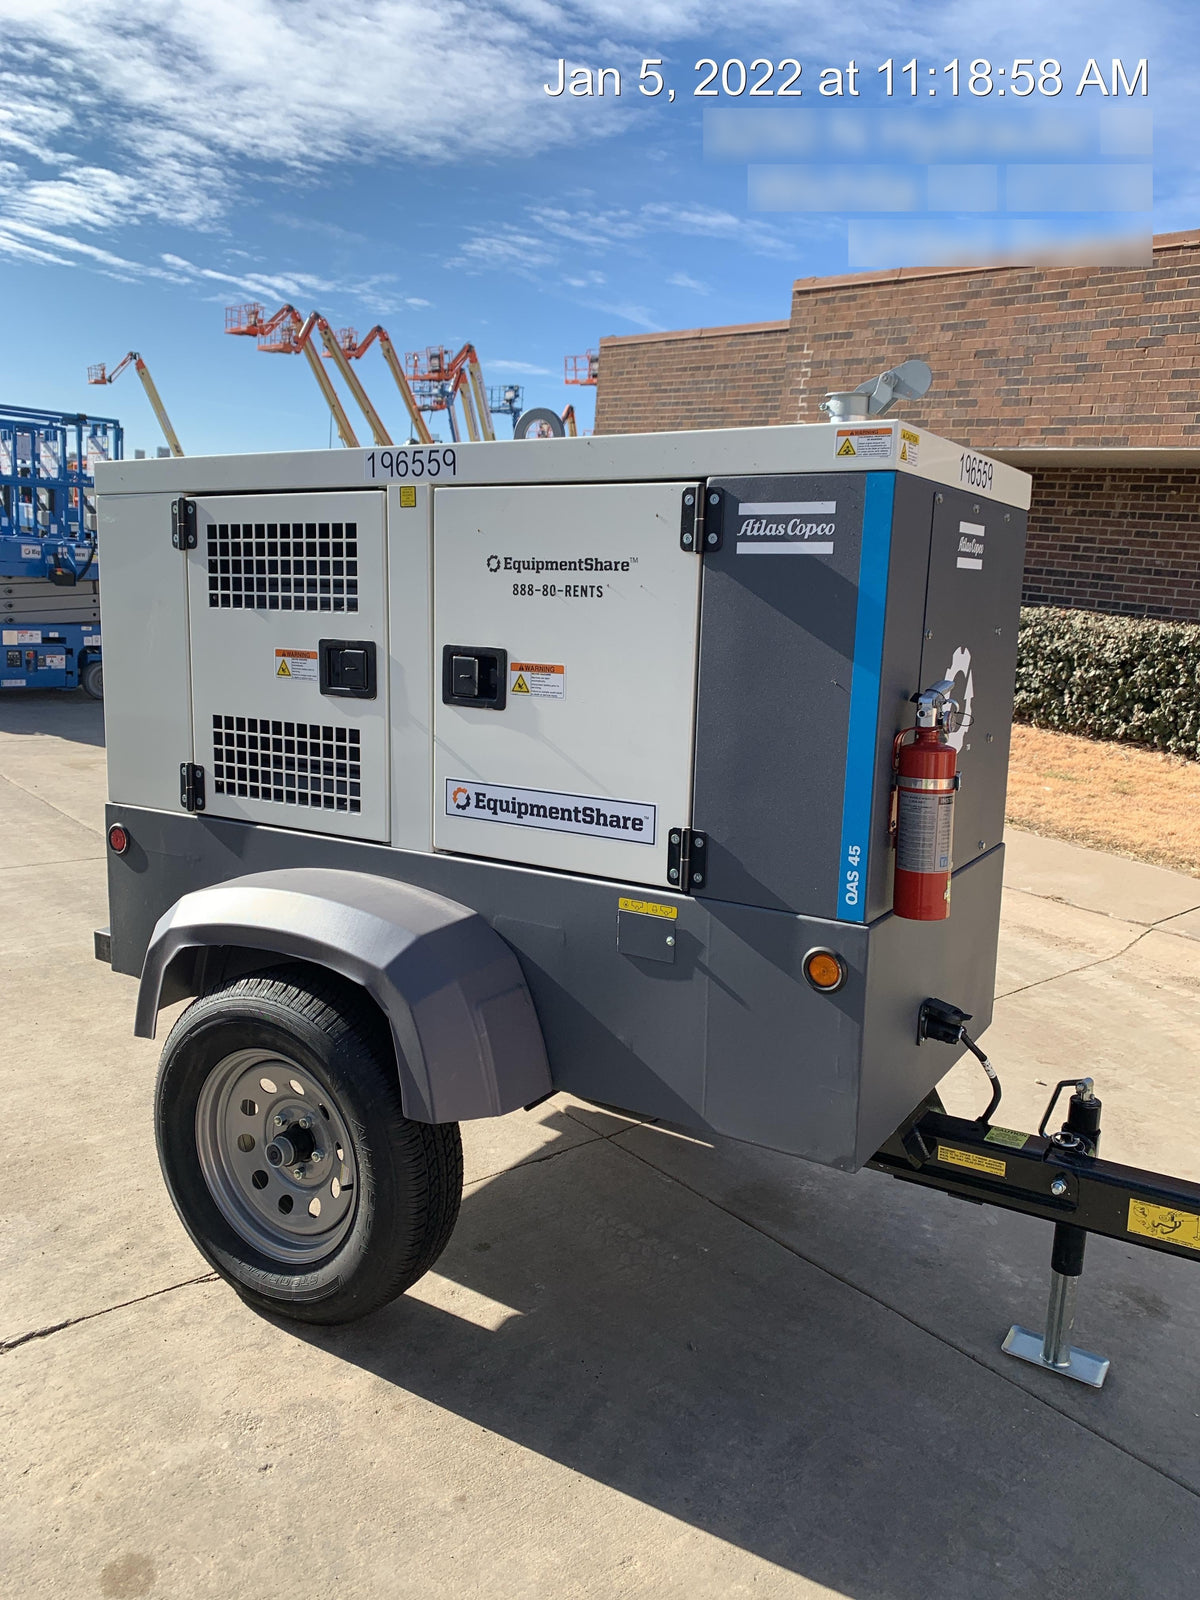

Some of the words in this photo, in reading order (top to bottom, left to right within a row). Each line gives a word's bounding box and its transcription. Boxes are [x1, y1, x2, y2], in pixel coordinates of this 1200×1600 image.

[367, 449, 457, 478] 196559
[959, 452, 993, 491] 196559
[736, 518, 786, 537] Atlas
[787, 518, 836, 540] Copco
[512, 583, 604, 598] 888-80-RENTS
[524, 665, 556, 673] WARNING
[848, 845, 861, 865] 45
[845, 871, 860, 905] QAS
